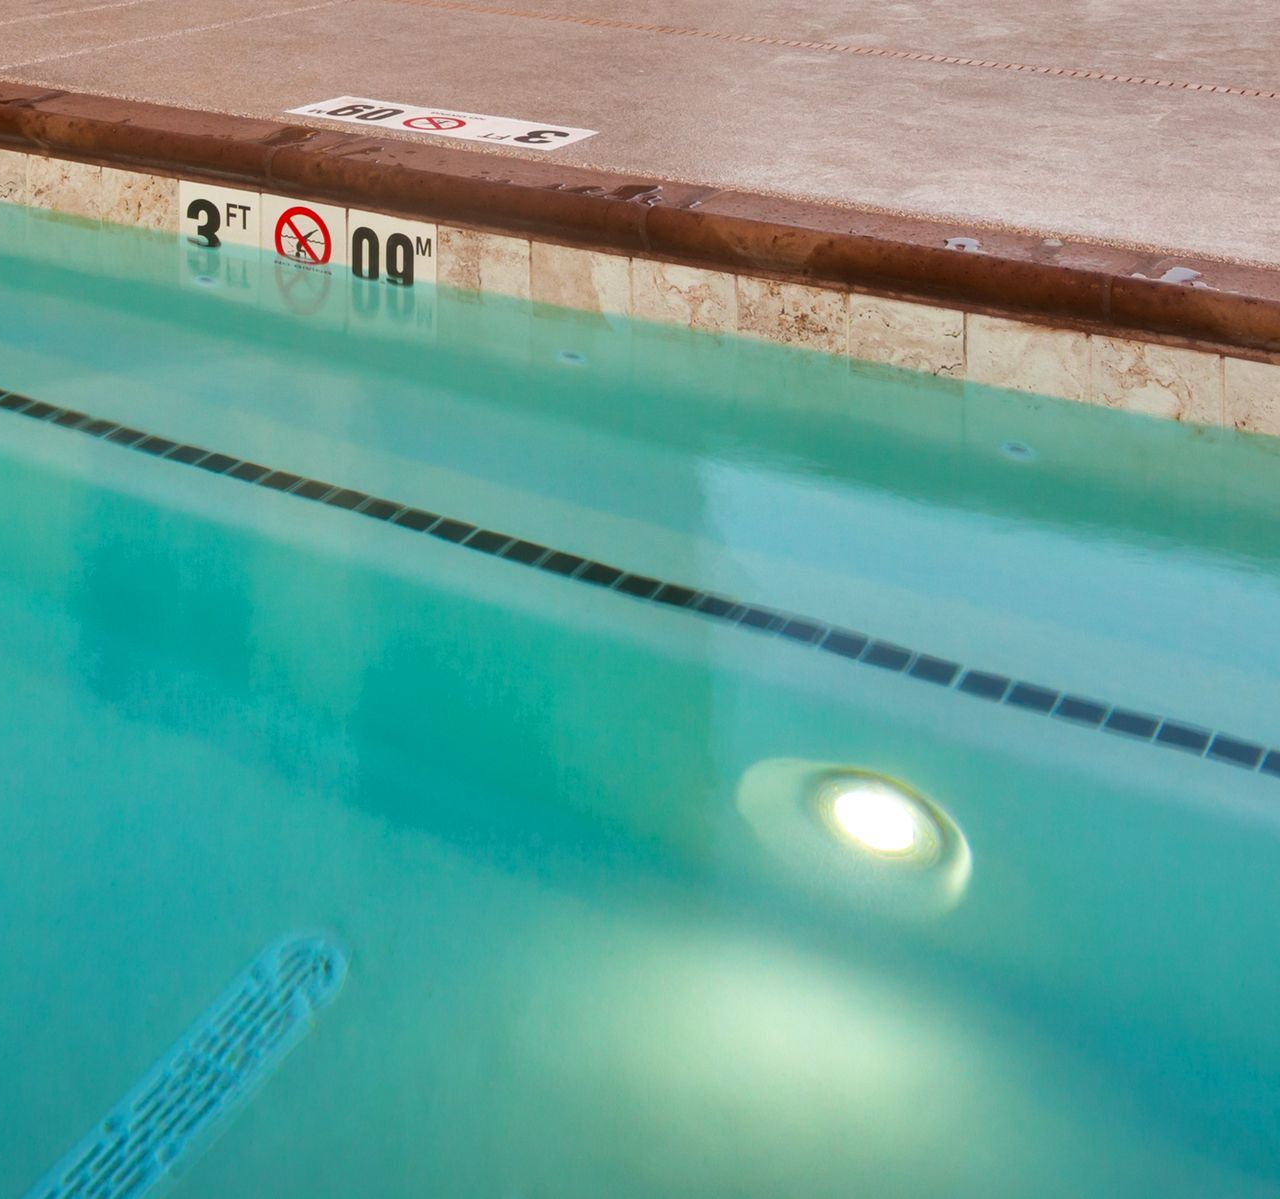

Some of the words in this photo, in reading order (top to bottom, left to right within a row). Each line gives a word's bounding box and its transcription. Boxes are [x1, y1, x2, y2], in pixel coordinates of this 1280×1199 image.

[476, 132, 511, 141] FT
[513, 130, 570, 144] 3
[186, 198, 222, 248] 3
[226, 203, 252, 230] FT
[415, 236, 432, 258] M
